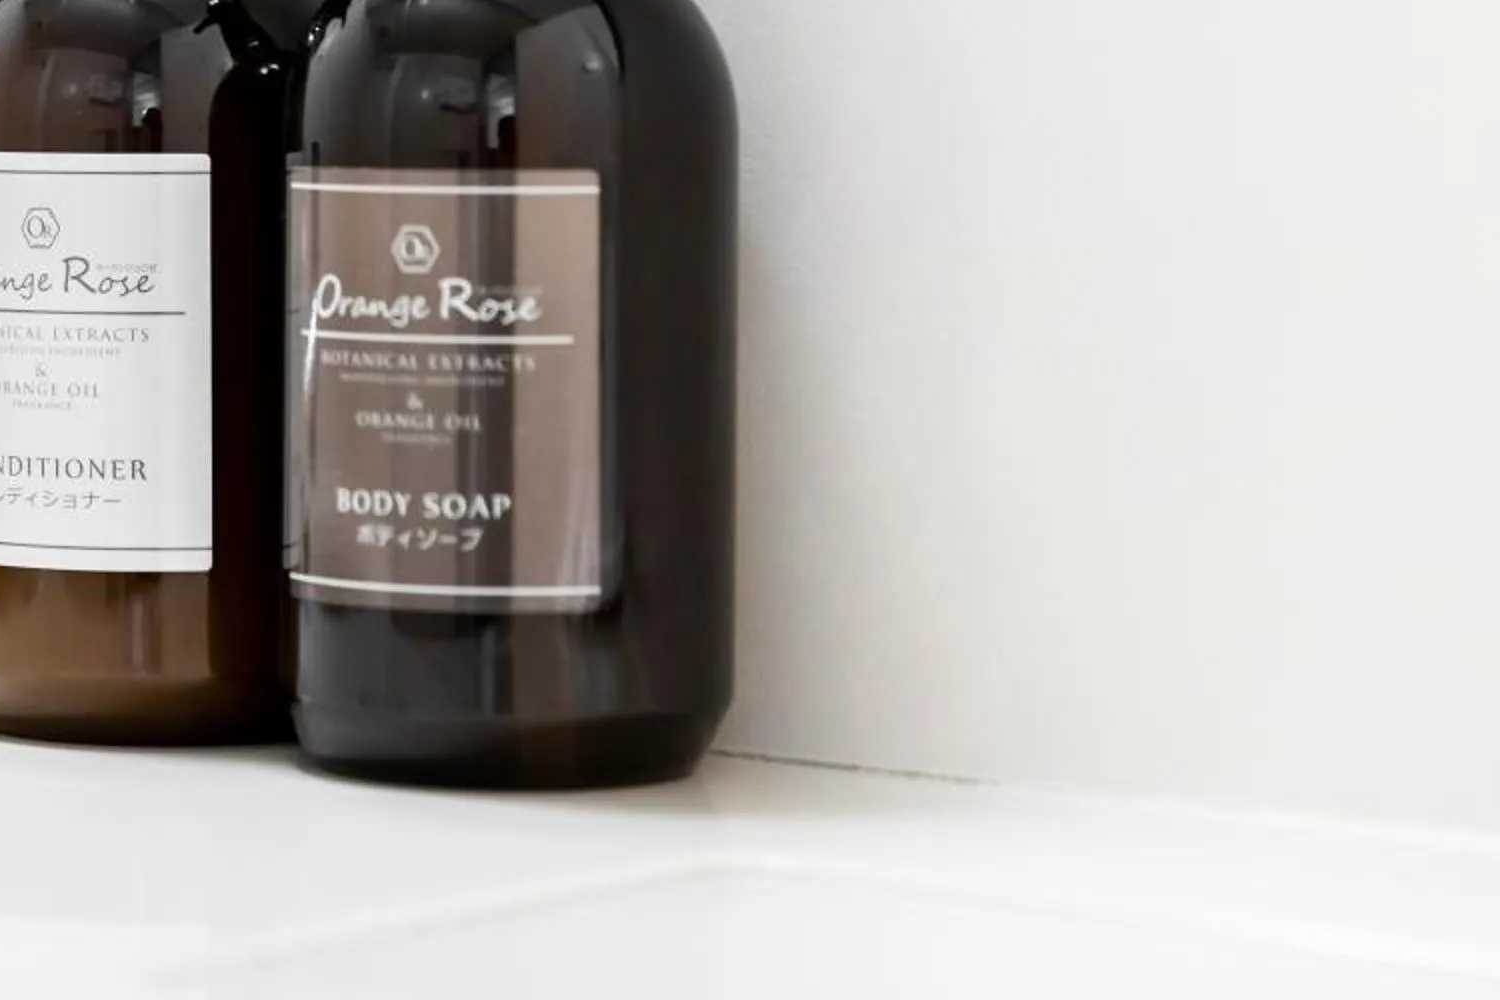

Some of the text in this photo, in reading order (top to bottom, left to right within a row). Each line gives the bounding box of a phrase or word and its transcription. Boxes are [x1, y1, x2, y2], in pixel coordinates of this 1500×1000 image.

[62, 256, 155, 297] Rose
[314, 273, 544, 328] Orange Rose
[52, 327, 150, 343] EXTRACTS
[35, 361, 49, 377] &
[320, 349, 418, 371] BOTANICAL
[67, 381, 101, 398] OIL
[354, 410, 482, 432] ORANGE OIL
[336, 487, 512, 521] BODY SOAP
